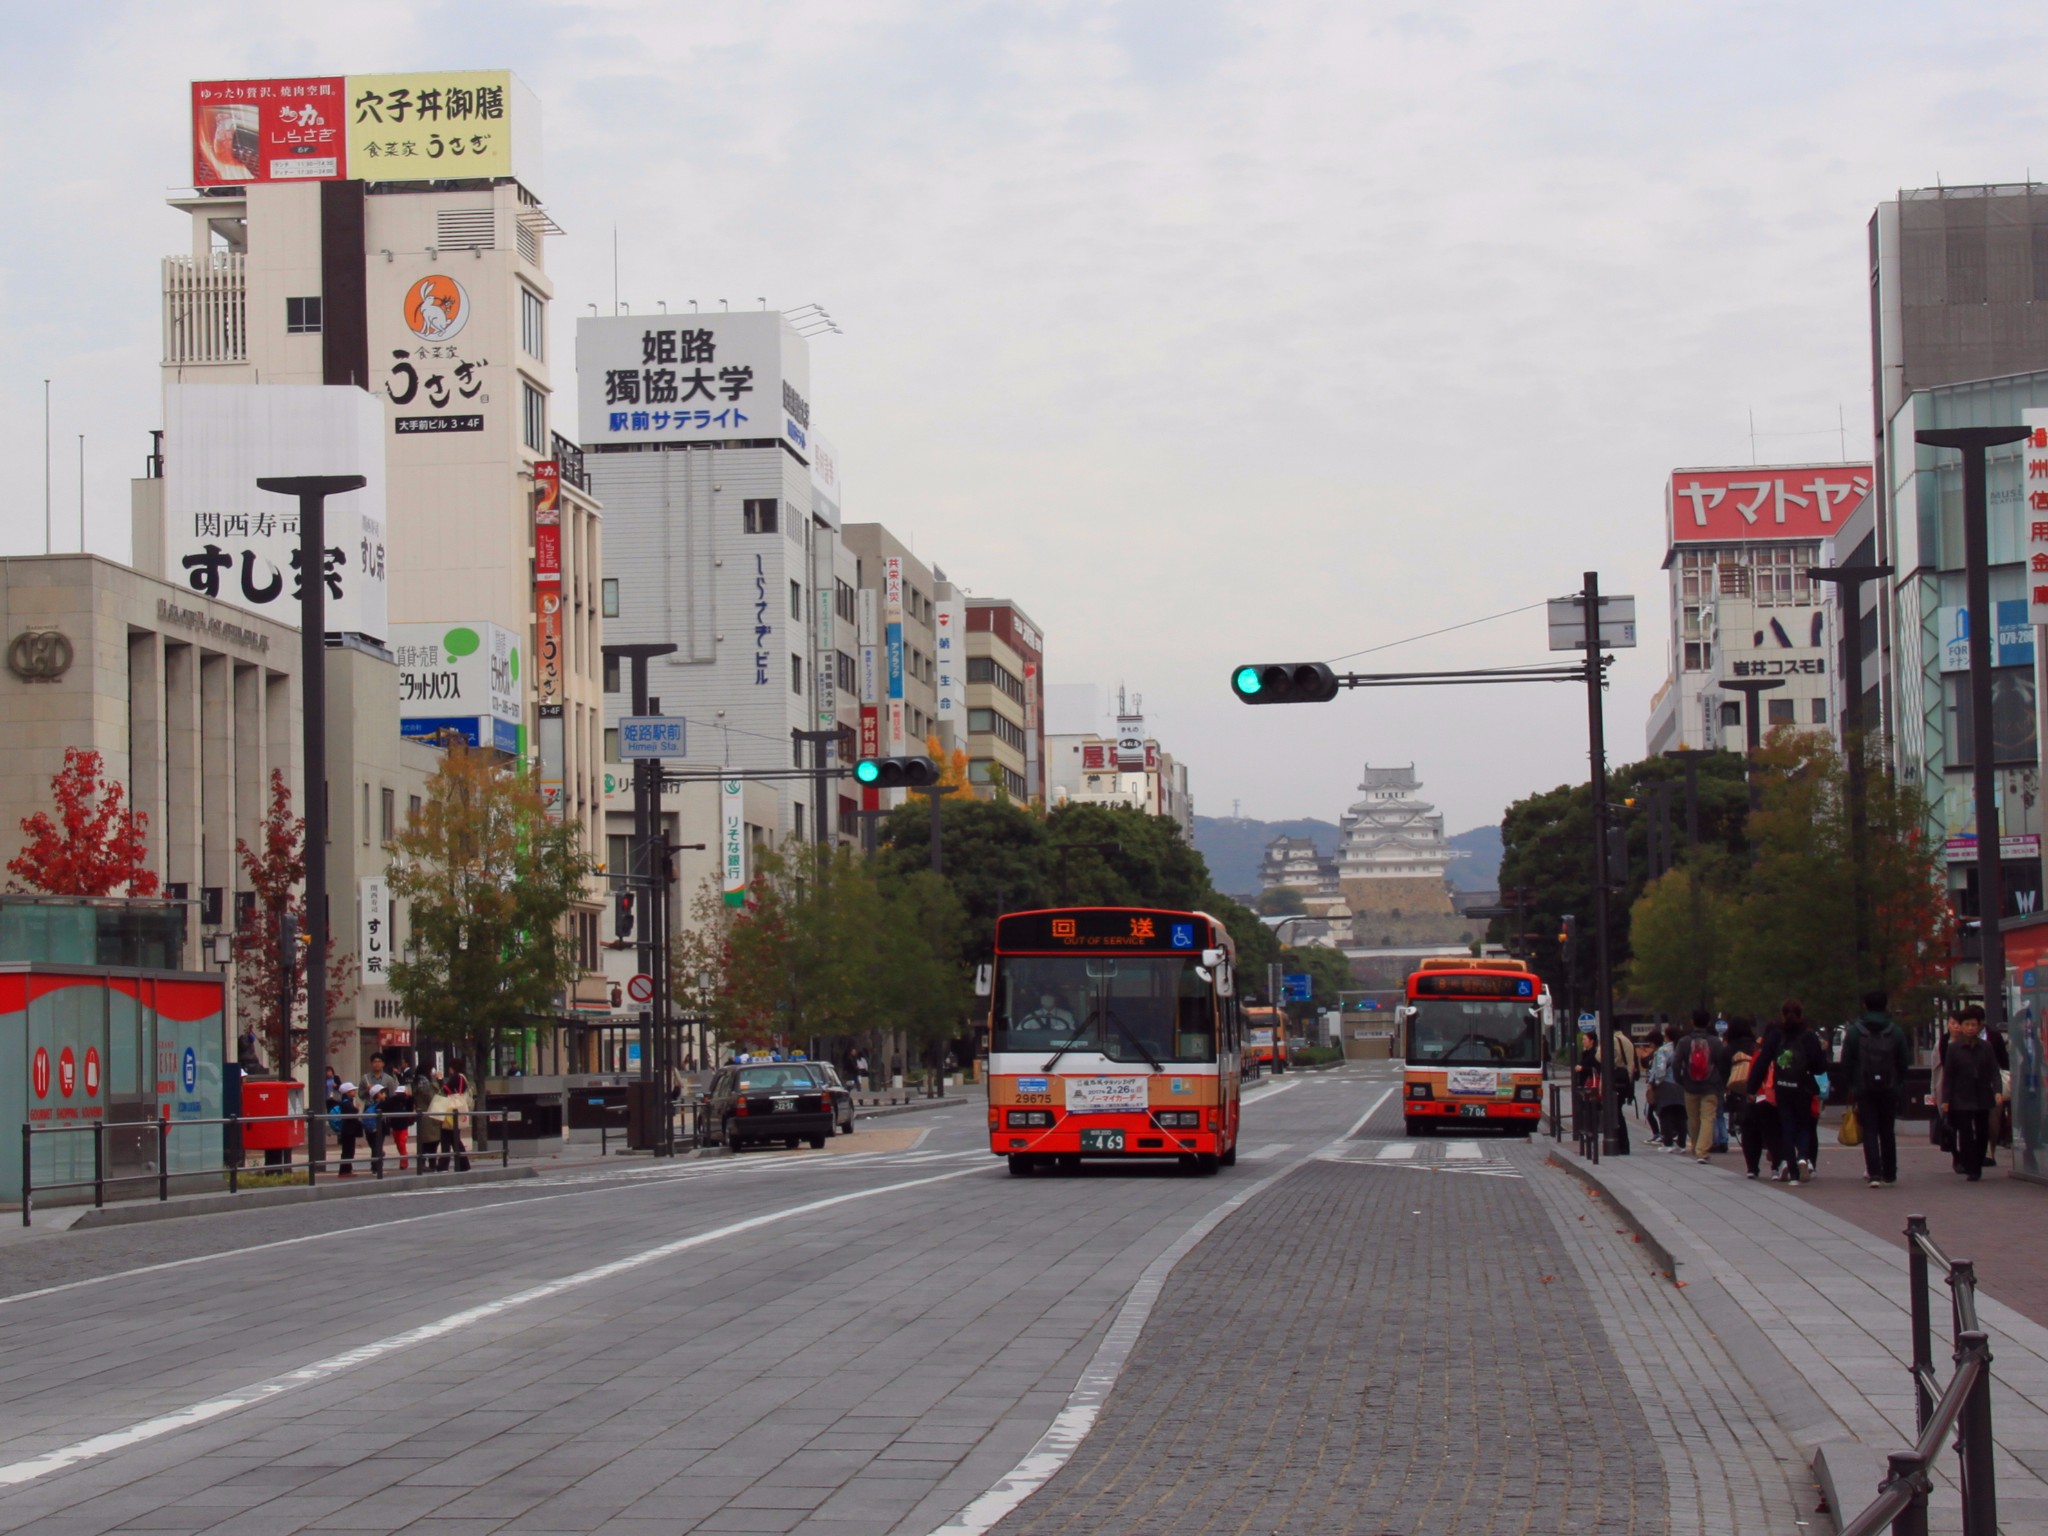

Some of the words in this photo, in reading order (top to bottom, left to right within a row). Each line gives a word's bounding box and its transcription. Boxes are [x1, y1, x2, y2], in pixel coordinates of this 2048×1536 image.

[355, 85, 504, 124] 穴子丼御膳
[426, 133, 492, 159] うさぎ
[642, 328, 717, 366] 姫路
[385, 349, 489, 409] うさぎ
[605, 365, 754, 405] 獨協大学
[399, 420, 447, 431] 大手前ビル
[608, 408, 749, 432] 駅前サテライト
[194, 511, 301, 539] 関西寿司
[939, 637, 951, 710] 第一生命
[624, 724, 681, 741] 姫路駅前
[628, 742, 657, 752] Himeji
[863, 716, 876, 760] 野村證
[727, 816, 740, 880] りそな銀行
[367, 918, 382, 973] すし宗
[1064, 936, 1083, 945] OUT
[1087, 936, 1100, 945] OF
[1103, 936, 1145, 945] SERVICE
[1015, 1094, 1052, 1104] 29675
